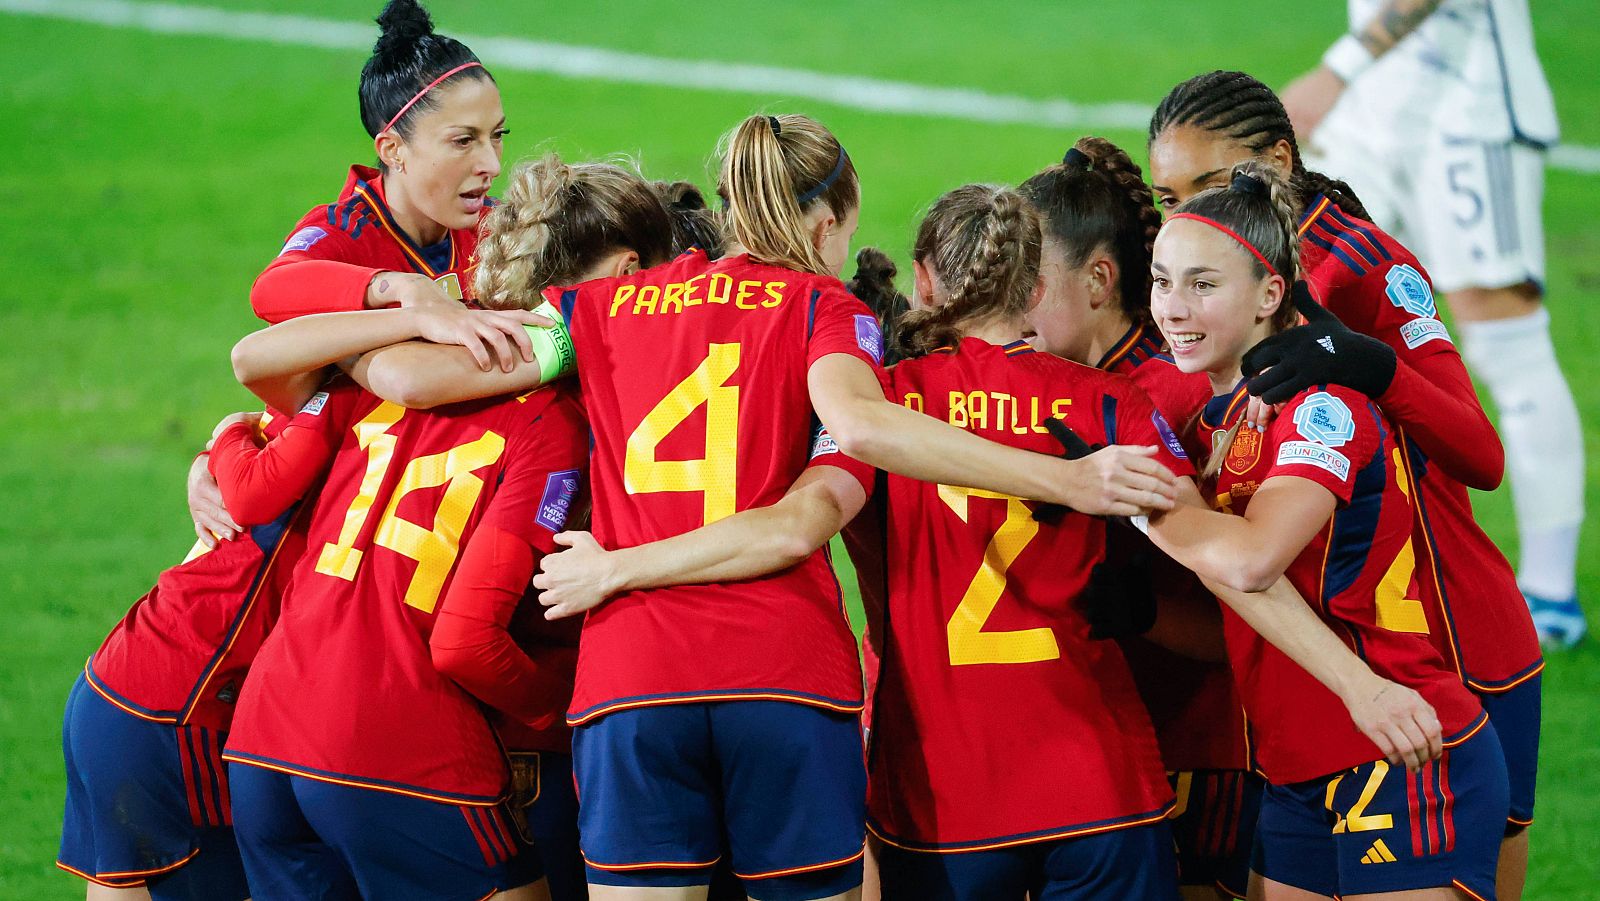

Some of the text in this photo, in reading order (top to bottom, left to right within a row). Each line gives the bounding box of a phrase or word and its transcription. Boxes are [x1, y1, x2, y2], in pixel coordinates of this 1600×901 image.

[1446, 160, 1484, 229] 5
[609, 272, 788, 318] PAREDES
[623, 342, 741, 527] 4
[948, 390, 1073, 435] BATLLE
[1280, 447, 1349, 474] FOUNDATION
[315, 400, 506, 615] 14
[937, 483, 1061, 666] 2
